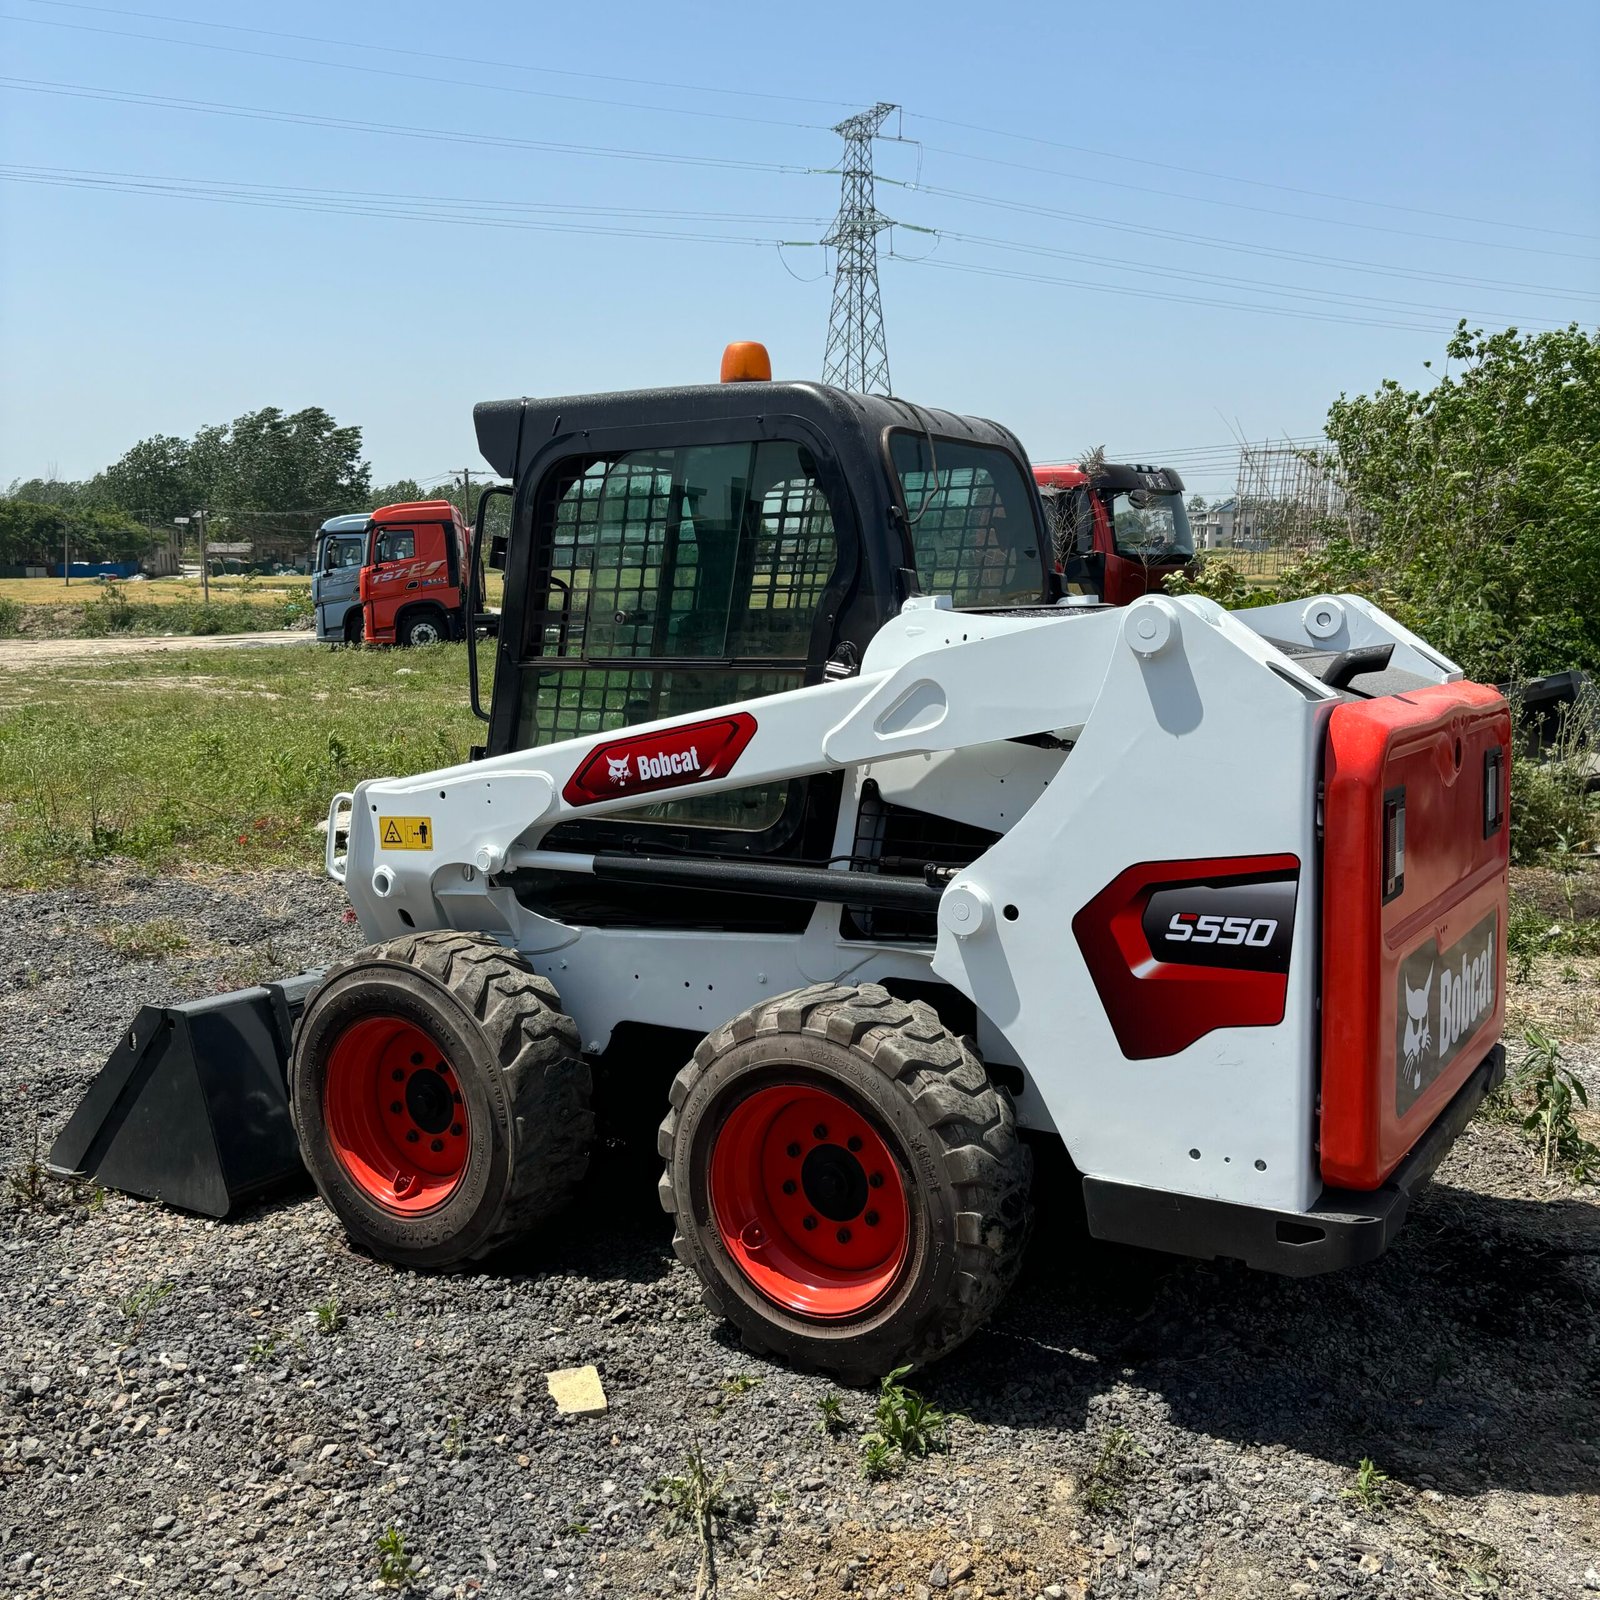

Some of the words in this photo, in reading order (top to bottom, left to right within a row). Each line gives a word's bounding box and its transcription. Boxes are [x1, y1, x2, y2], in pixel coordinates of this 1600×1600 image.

[636, 746, 701, 781] Bobcat
[1165, 912, 1278, 947] S550
[1439, 931, 1493, 1059] Bobcat
[811, 1047, 859, 1076] PROTECTED
[857, 1071, 881, 1094] WALL
